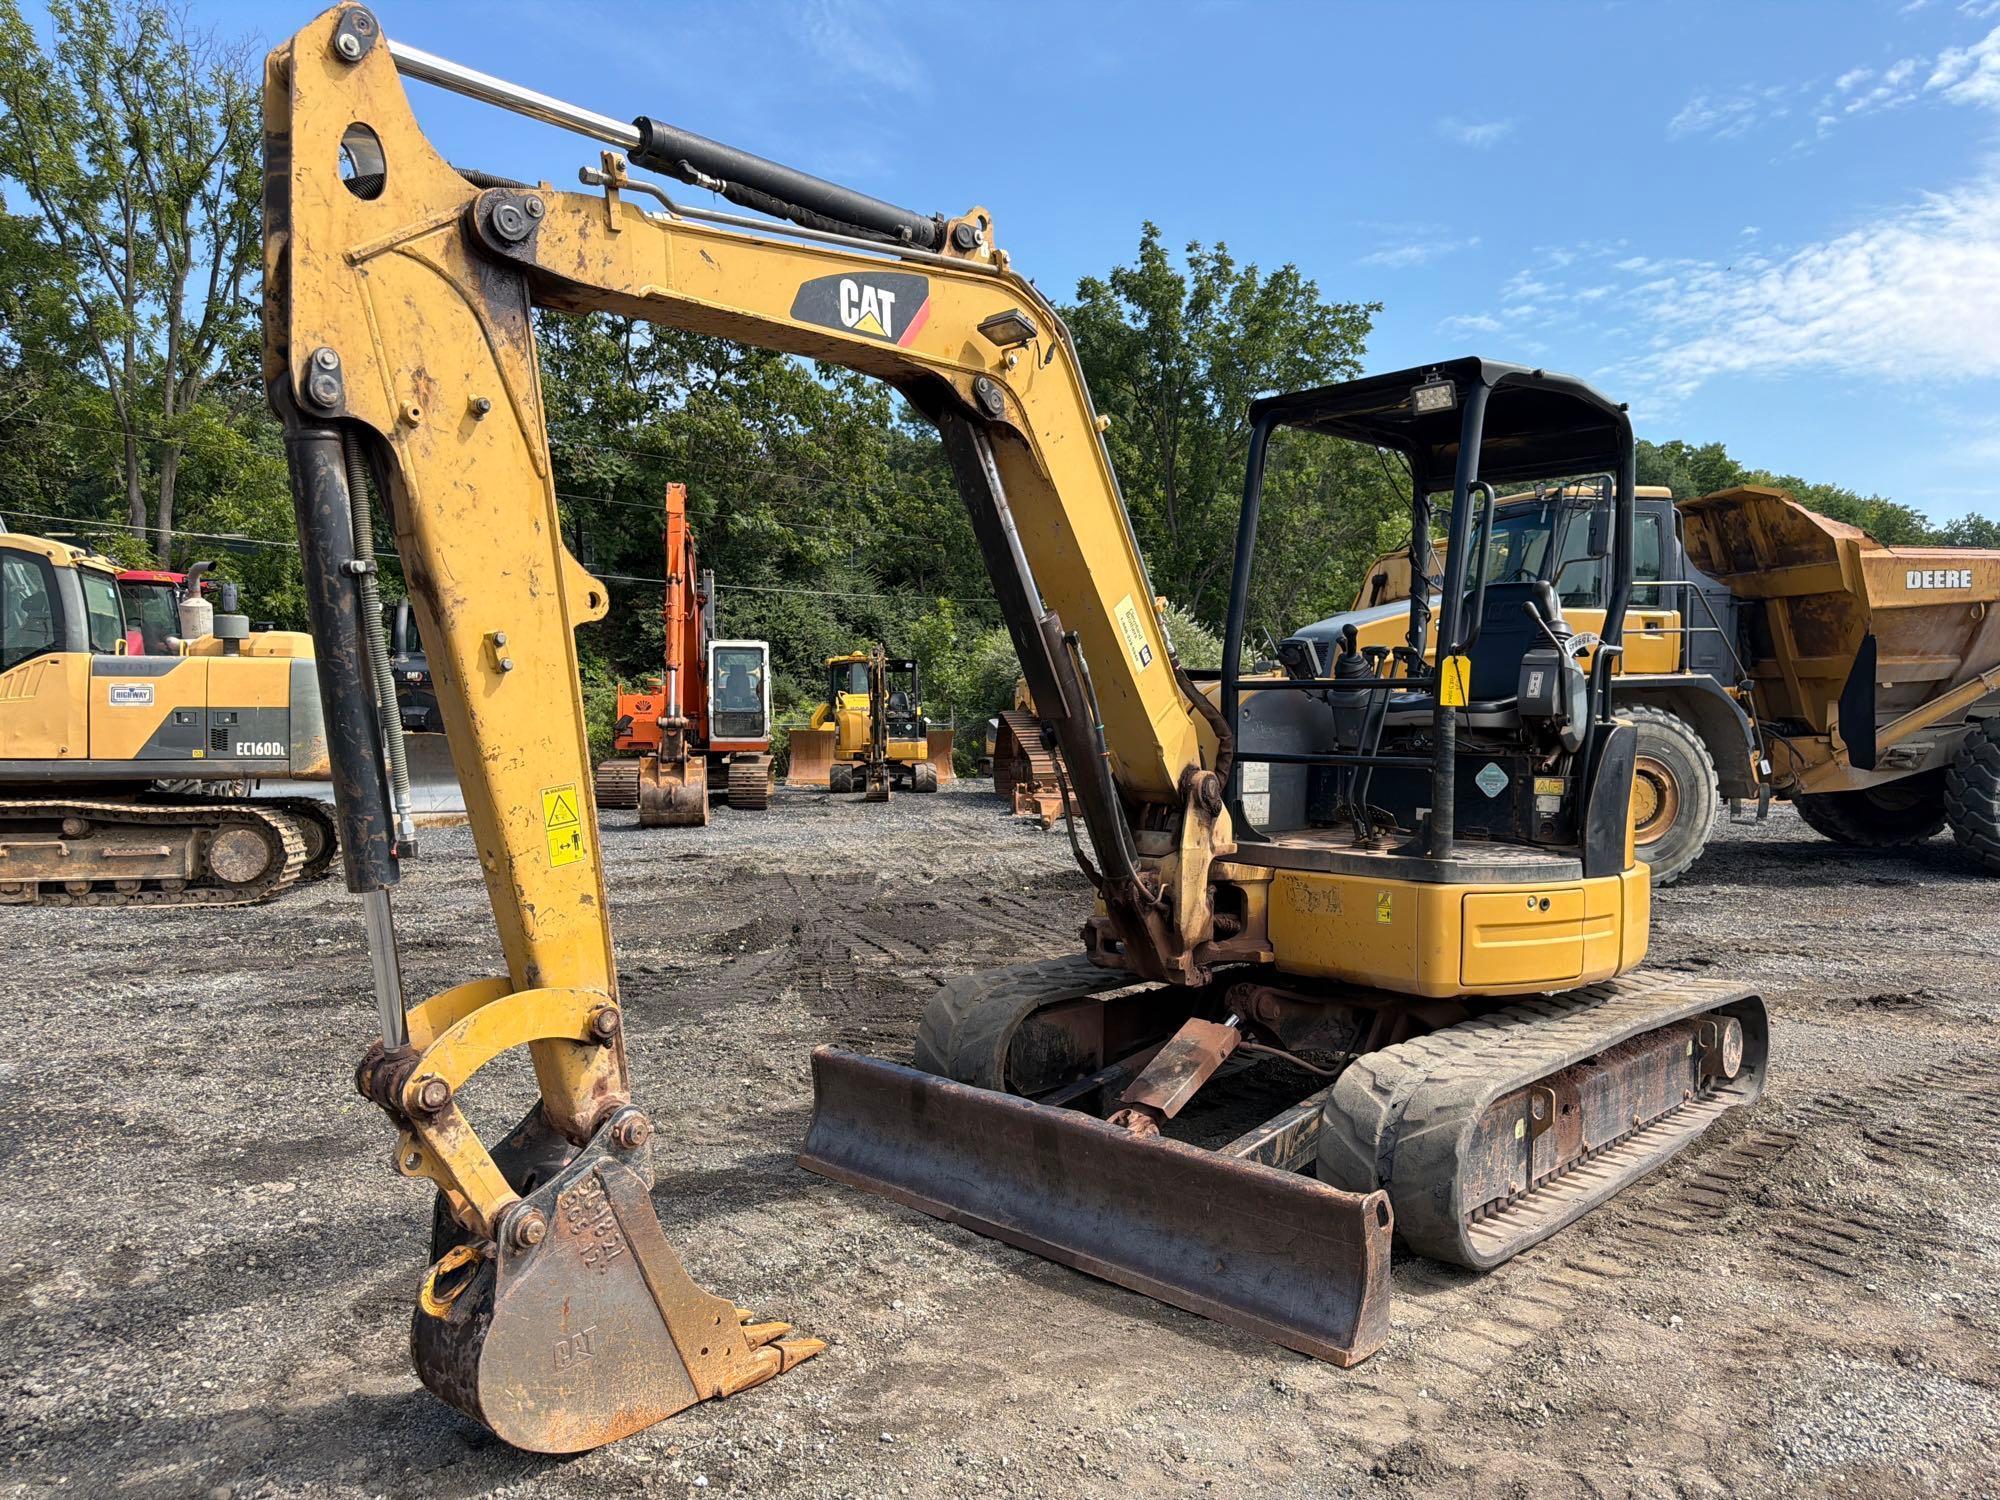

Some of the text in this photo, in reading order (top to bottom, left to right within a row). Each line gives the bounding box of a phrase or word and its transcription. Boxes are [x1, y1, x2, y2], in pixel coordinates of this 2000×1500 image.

[840, 279, 895, 337] CAT
[1906, 570, 1972, 589] DEERE
[115, 691, 148, 699] HIGHWAY
[553, 1325, 597, 1371] CAT
